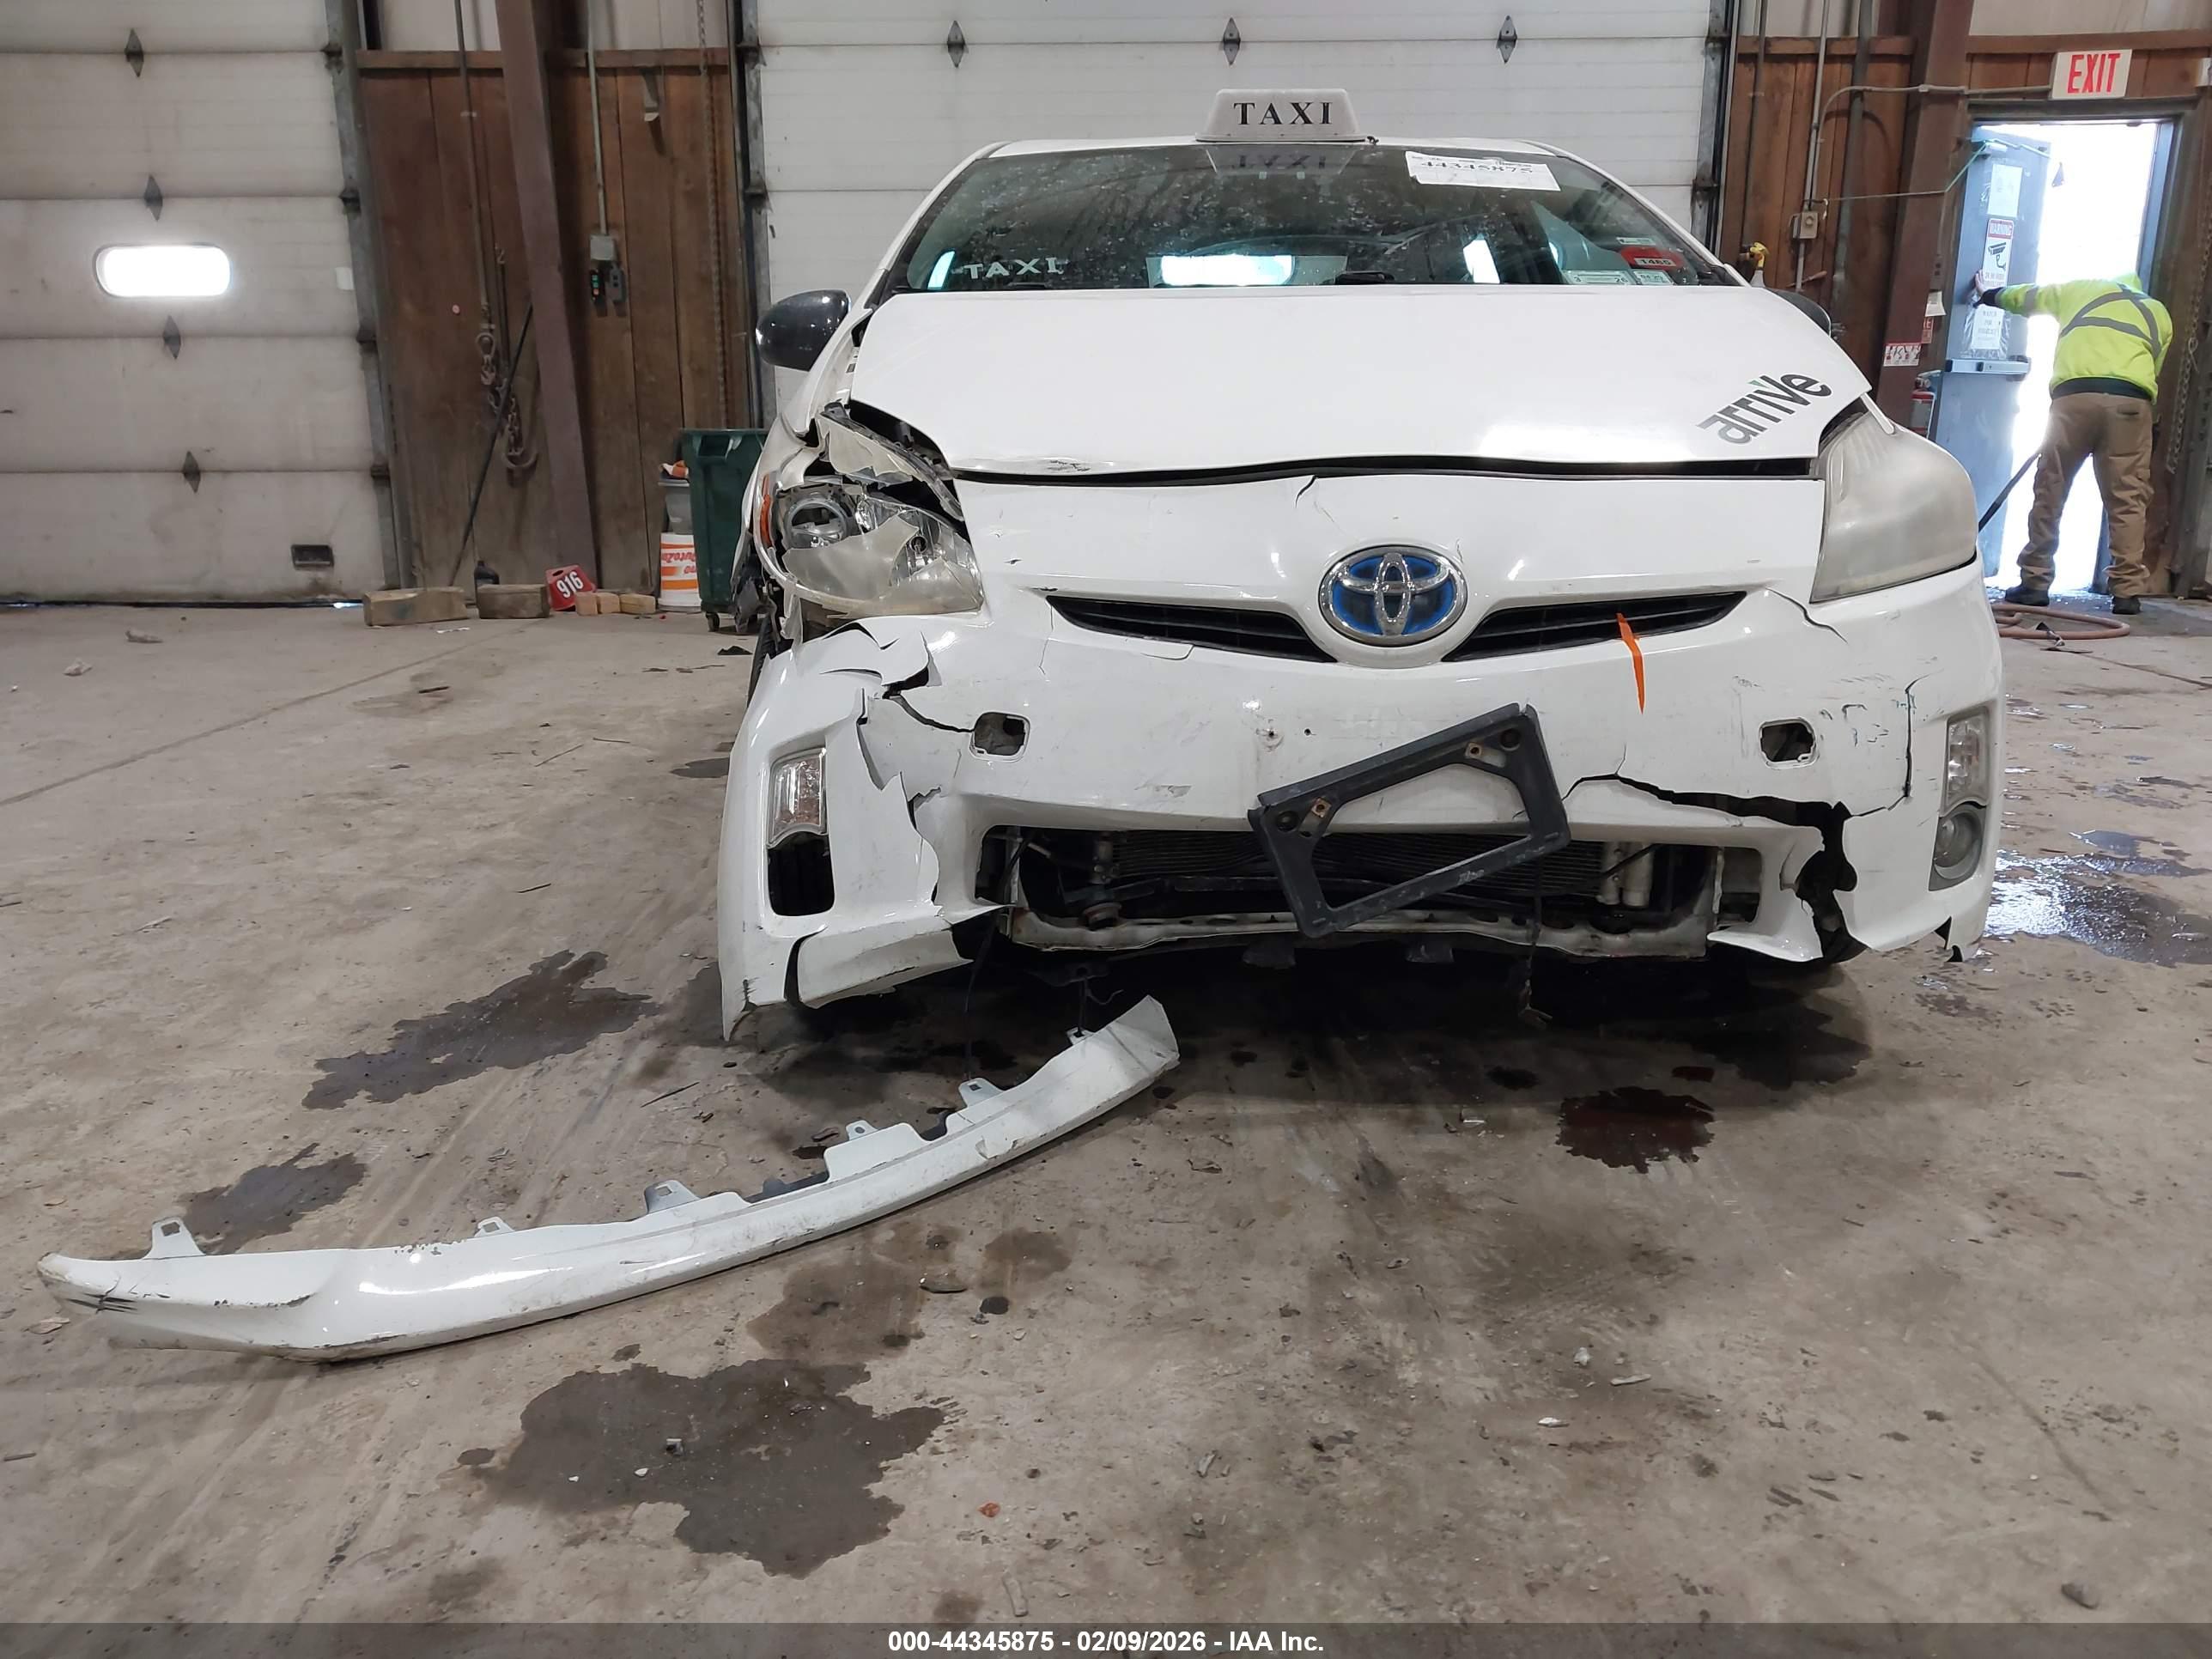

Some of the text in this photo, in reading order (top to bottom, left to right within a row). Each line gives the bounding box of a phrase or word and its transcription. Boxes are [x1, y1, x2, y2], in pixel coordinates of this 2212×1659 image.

[2067, 52, 2121, 94] EXIT
[1233, 101, 1333, 125] TAXI
[963, 257, 1058, 280] TAXI
[1695, 374, 1832, 445] arrive
[556, 571, 584, 599] 916
